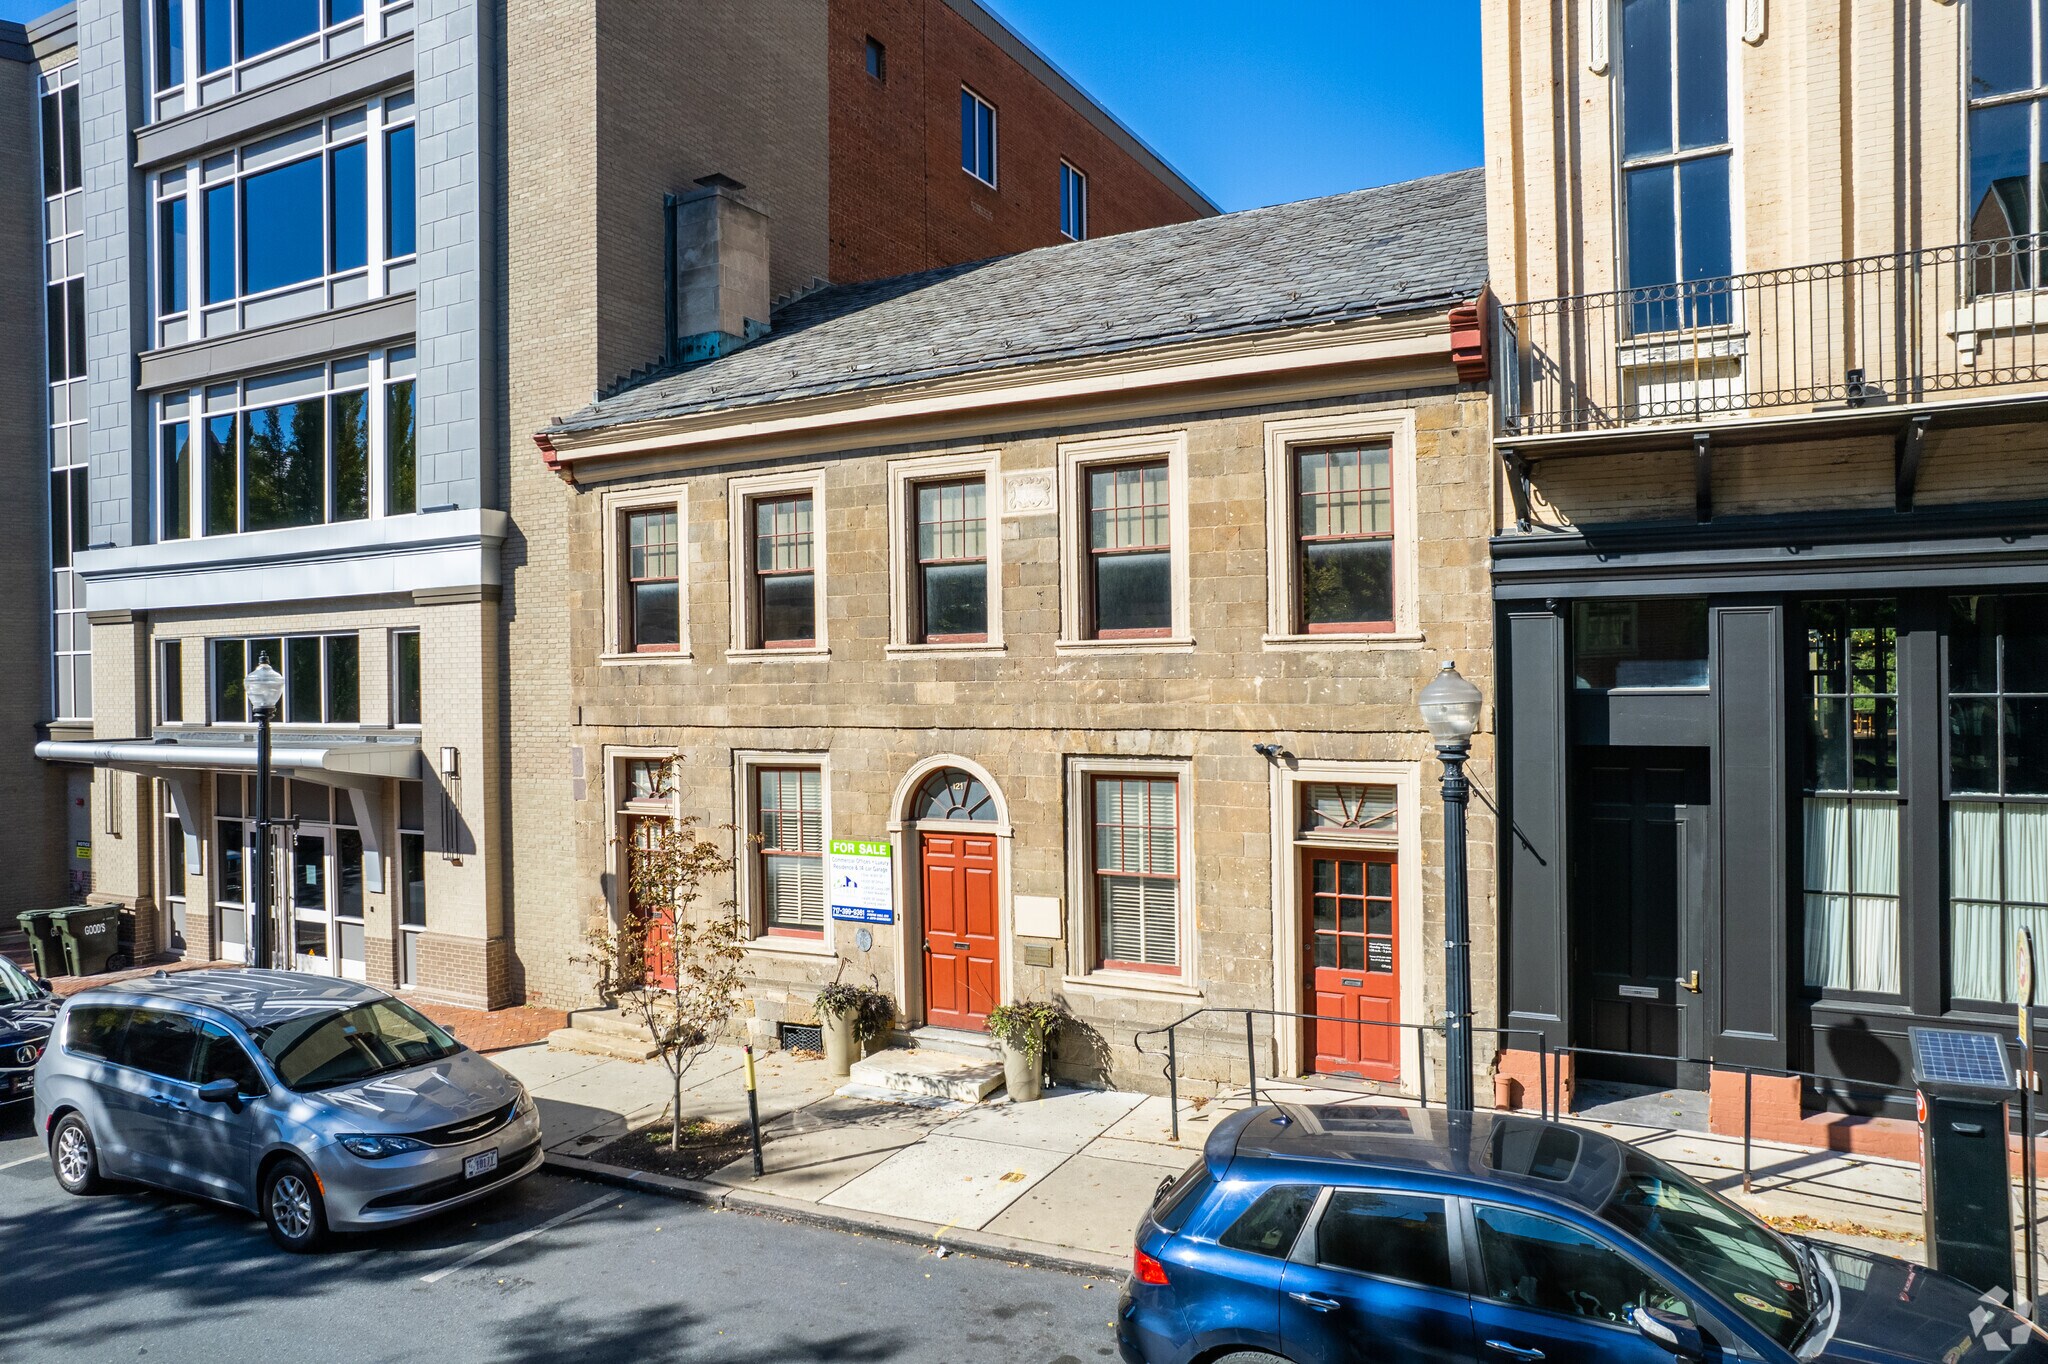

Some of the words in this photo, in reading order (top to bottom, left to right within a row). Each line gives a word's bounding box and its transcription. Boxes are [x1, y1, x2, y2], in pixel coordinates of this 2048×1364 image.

[833, 842, 855, 853] FOR
[858, 843, 887, 855] SALE
[84, 923, 106, 936] GOOD'S
